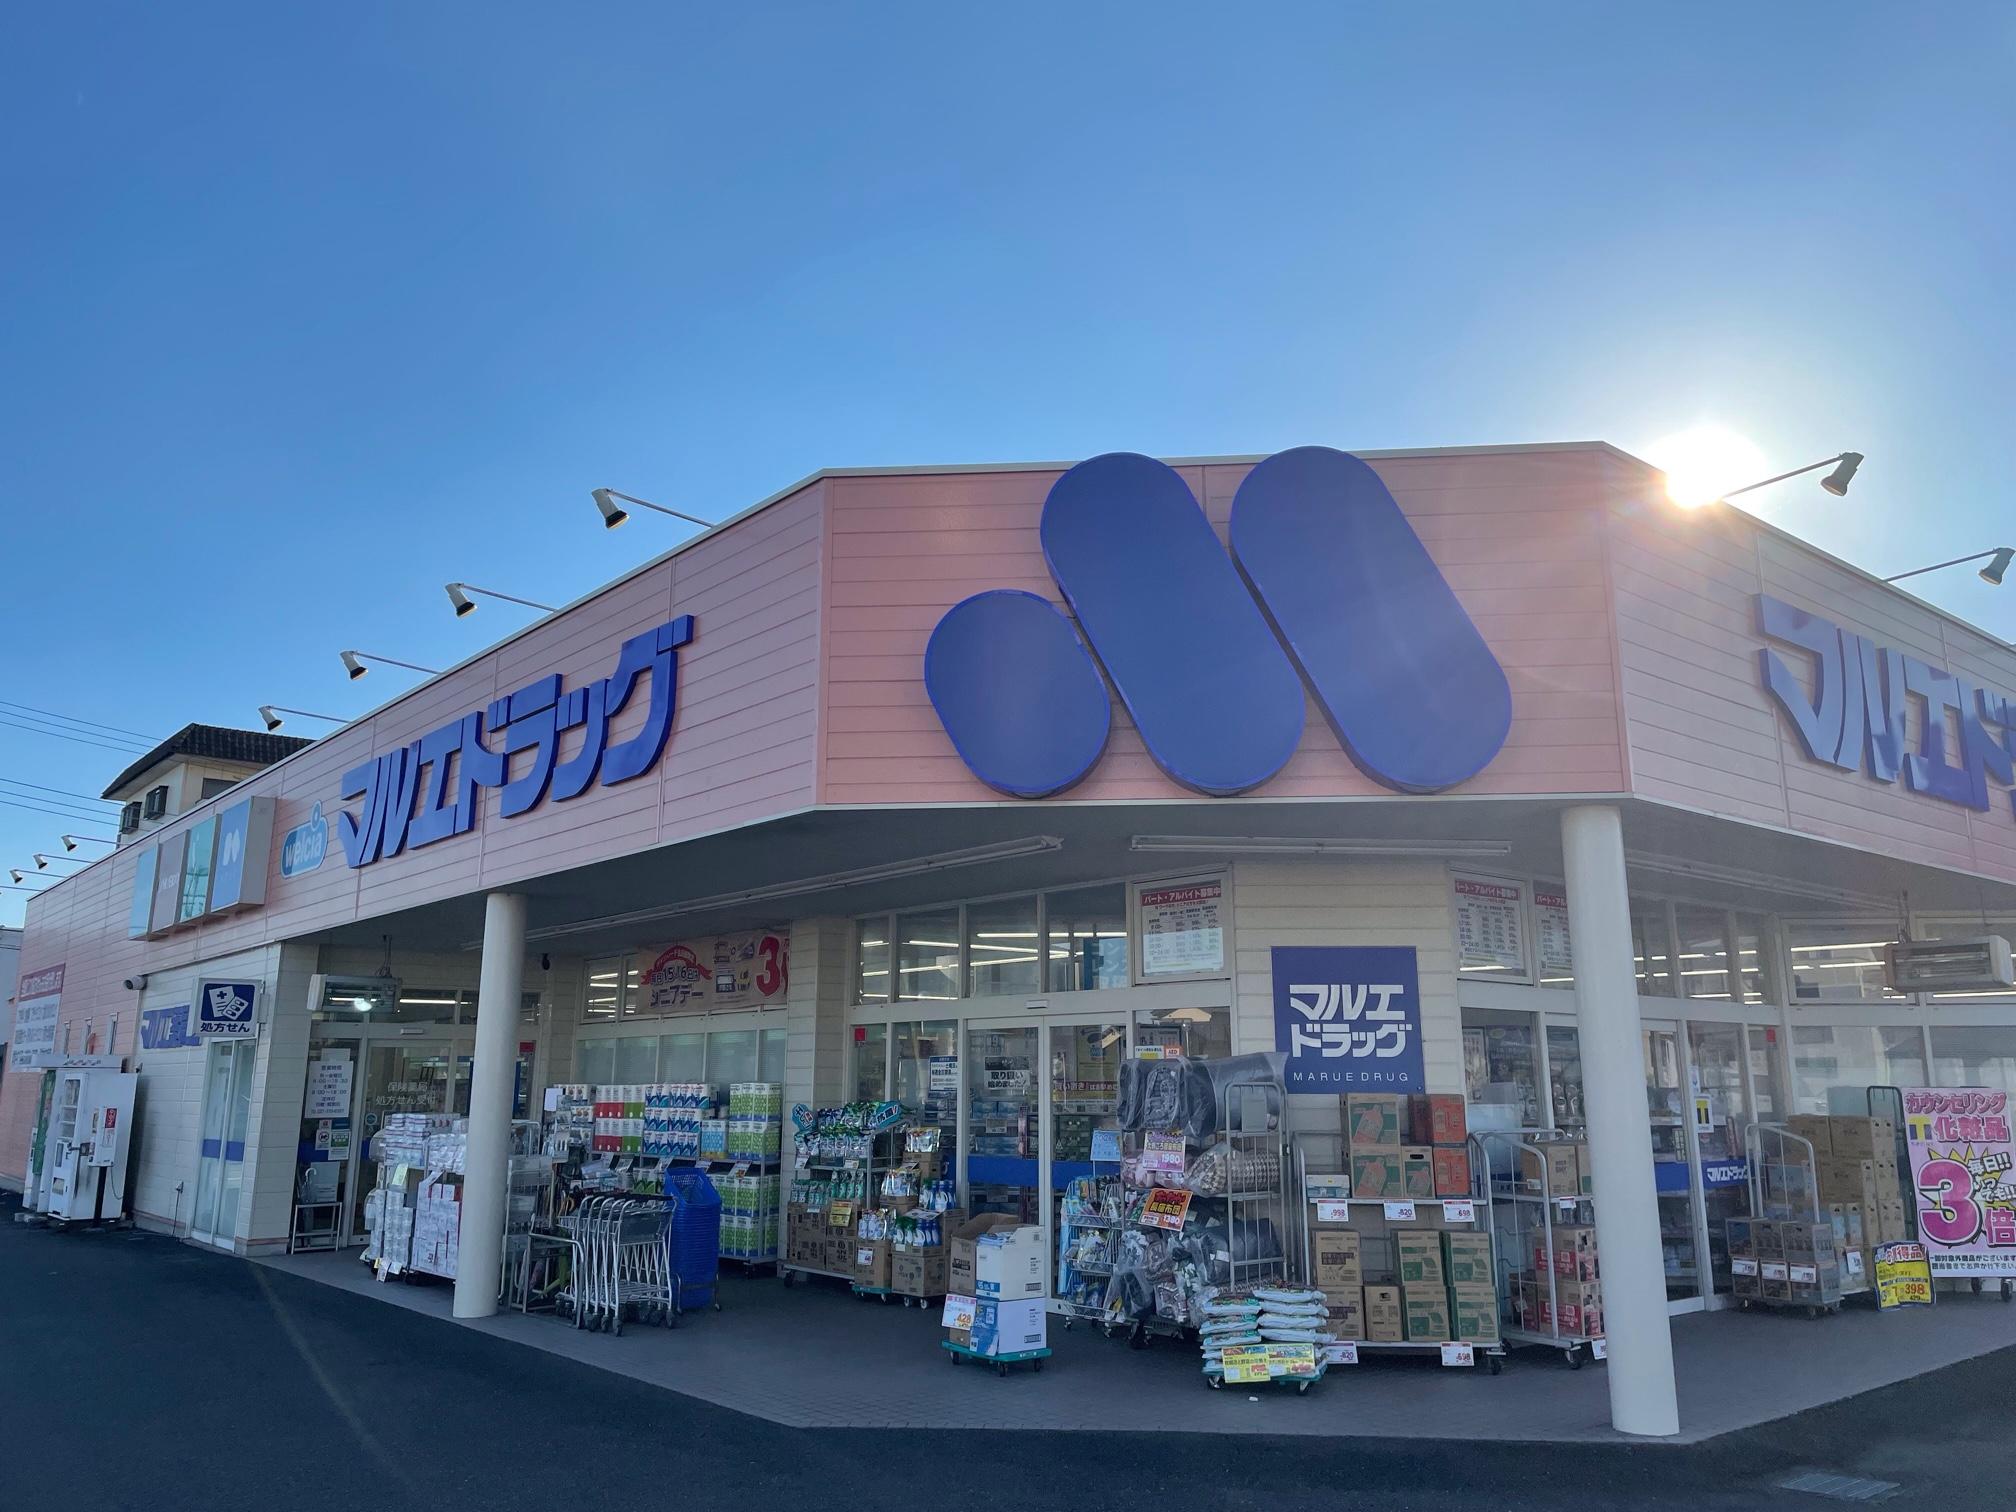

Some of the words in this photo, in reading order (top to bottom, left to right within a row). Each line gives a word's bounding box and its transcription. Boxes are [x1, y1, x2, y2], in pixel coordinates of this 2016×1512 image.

[1752, 593, 2016, 824] マルエド
[339, 614, 694, 869] マルエドラッグ
[285, 829, 323, 869] welcia
[1289, 983, 1406, 1021] マルエ
[200, 1022, 250, 1033] 処方せん
[1290, 1022, 1412, 1058] ドラッグ
[1293, 1071, 1353, 1081] MARUE
[1361, 1071, 1409, 1081] DRUG
[1905, 1092, 2007, 1114] カウンセリング
[1934, 1115, 2011, 1143] 化粧品
[1161, 1153, 1180, 1163] 1980
[1905, 1283, 1925, 1295] 398
